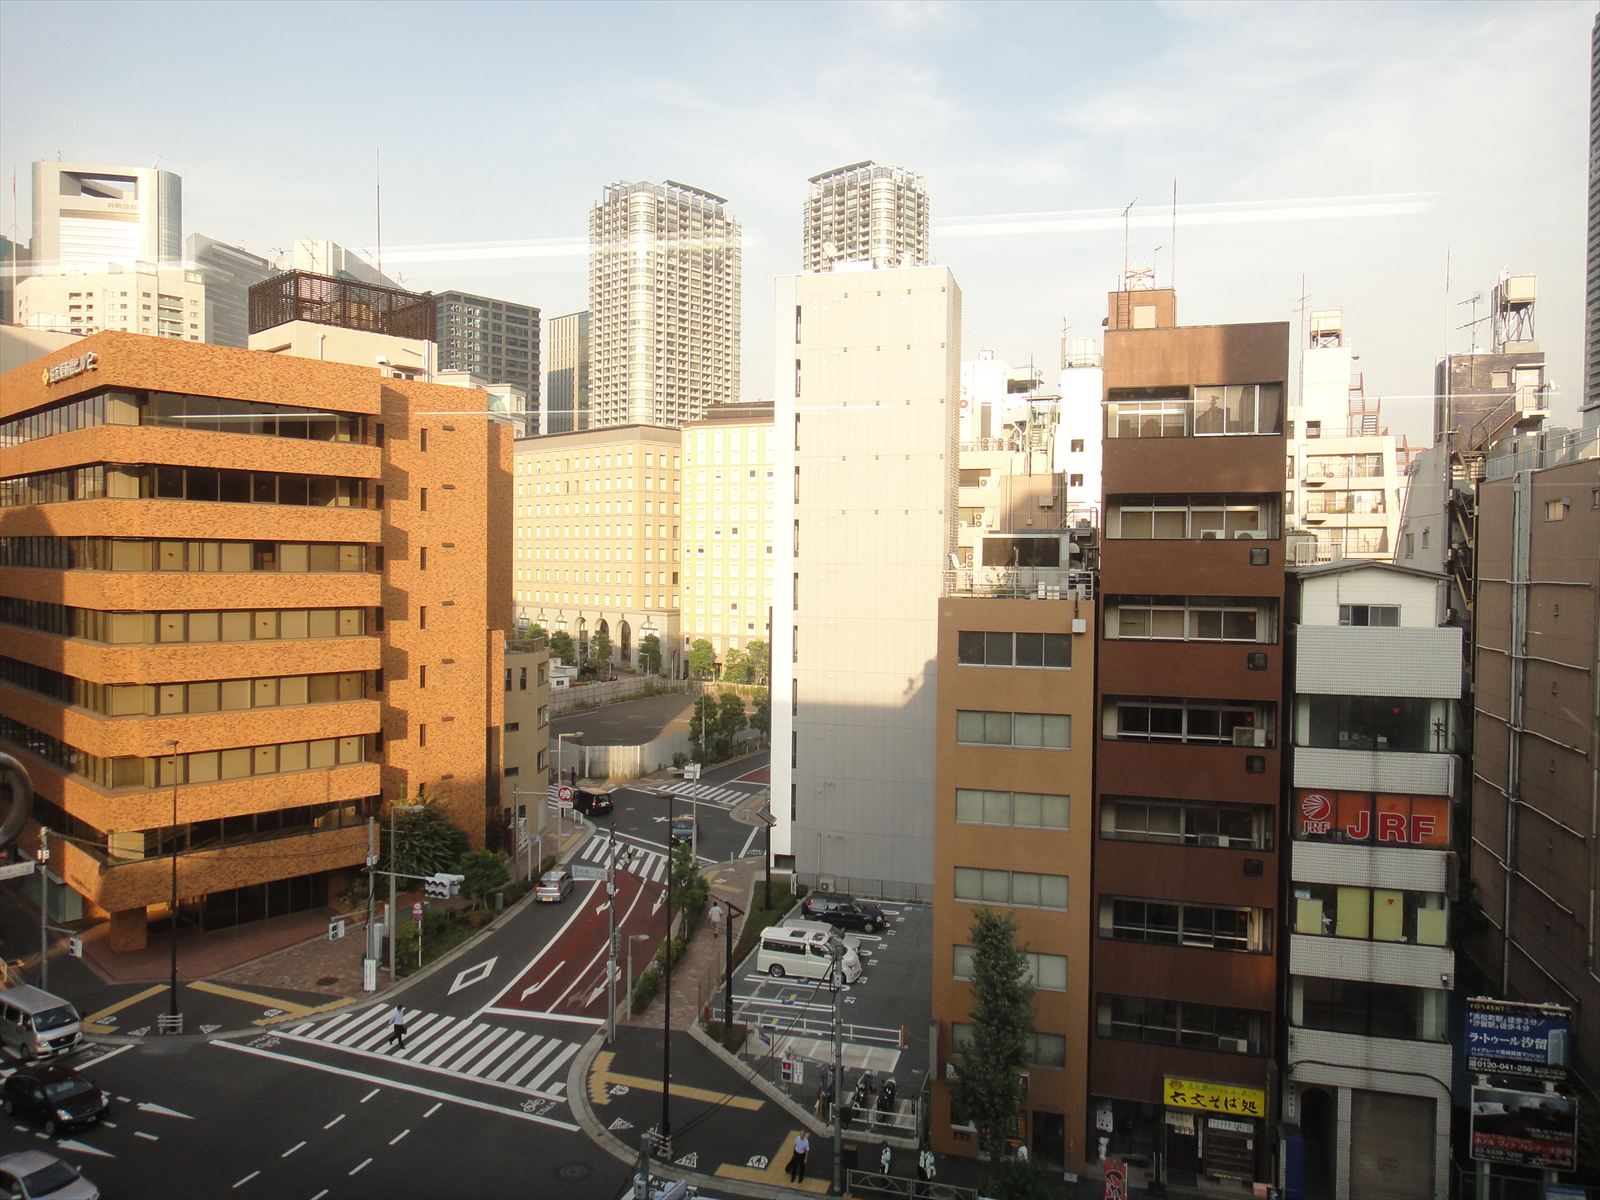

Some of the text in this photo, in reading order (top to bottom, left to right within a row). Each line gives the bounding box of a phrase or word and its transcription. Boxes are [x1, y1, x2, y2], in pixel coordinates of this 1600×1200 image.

[1302, 820, 1331, 835] JRF
[1347, 811, 1436, 844] JRF
[1170, 1091, 1259, 1114] 六文そば処
